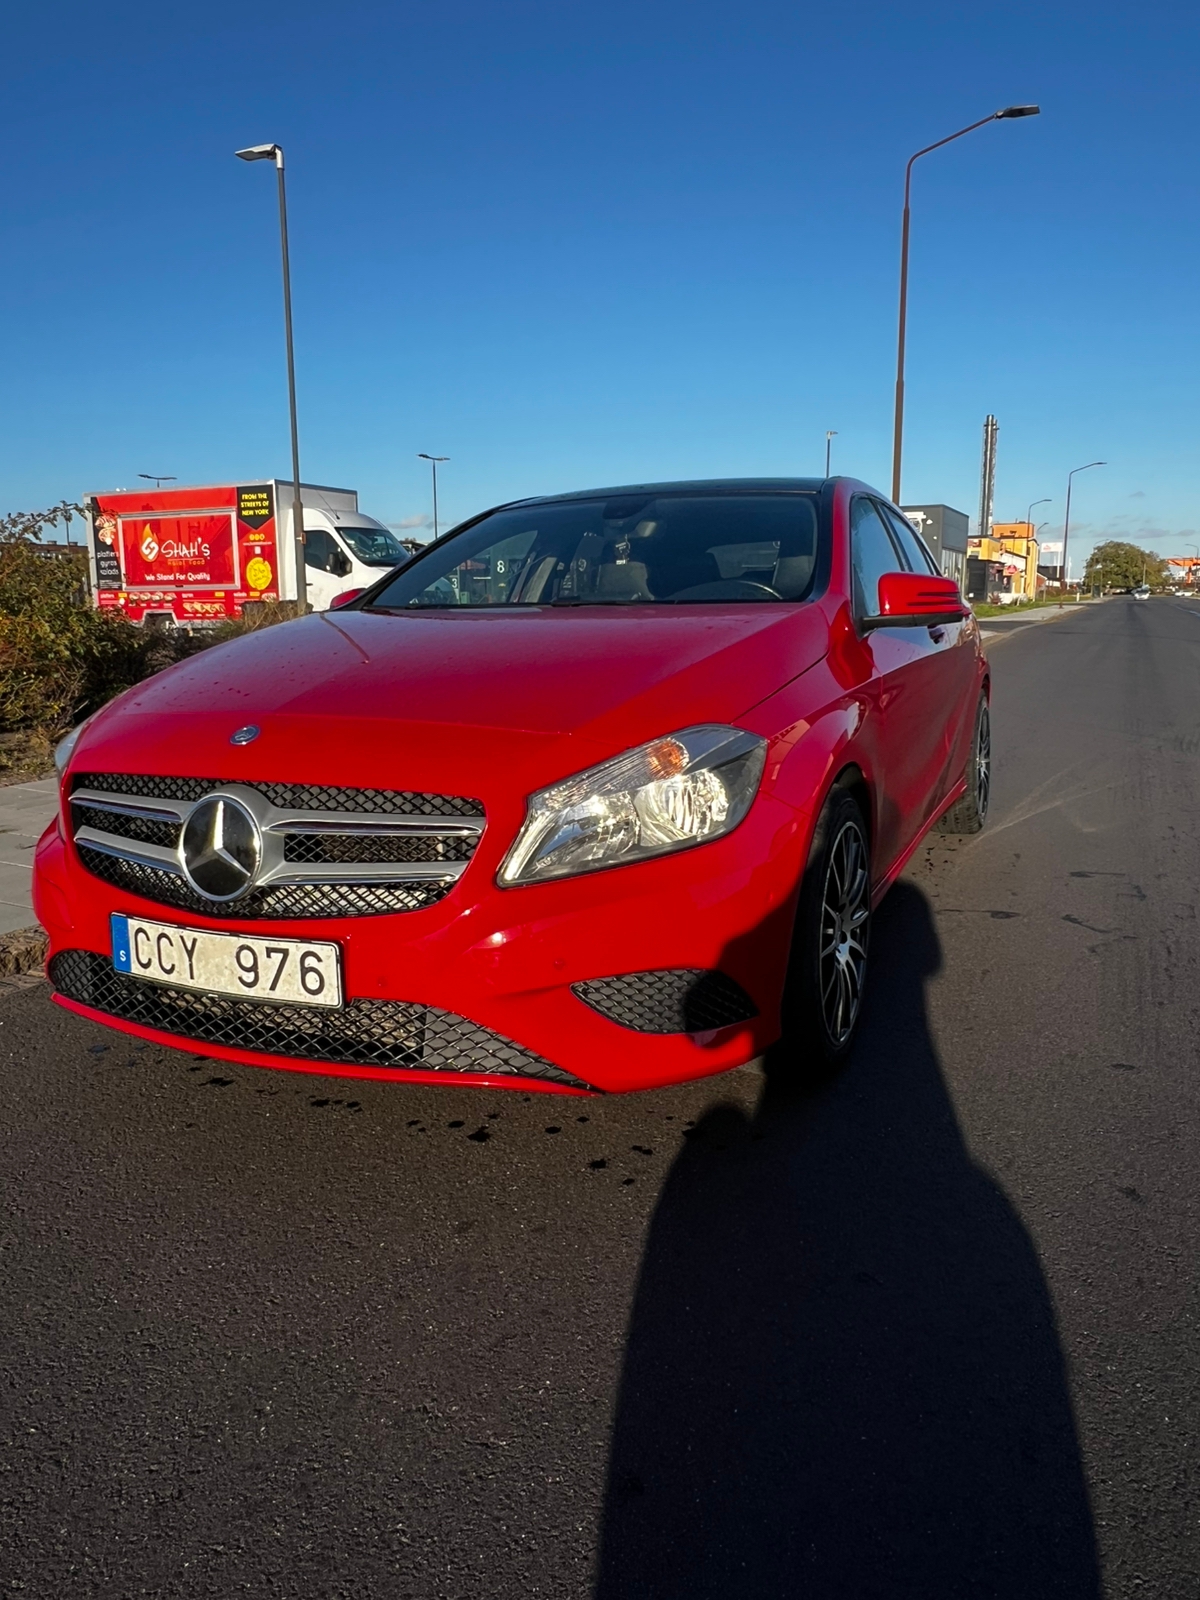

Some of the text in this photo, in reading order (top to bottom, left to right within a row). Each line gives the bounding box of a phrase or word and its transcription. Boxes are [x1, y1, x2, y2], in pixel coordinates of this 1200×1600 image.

[100, 560, 118, 568] gyros
[496, 560, 505, 574] 8
[144, 573, 156, 581] We
[156, 573, 175, 581] Stand
[187, 571, 211, 582] Quality
[451, 578, 459, 588] 3
[119, 949, 127, 962] S
[134, 927, 326, 996] CCY 976
